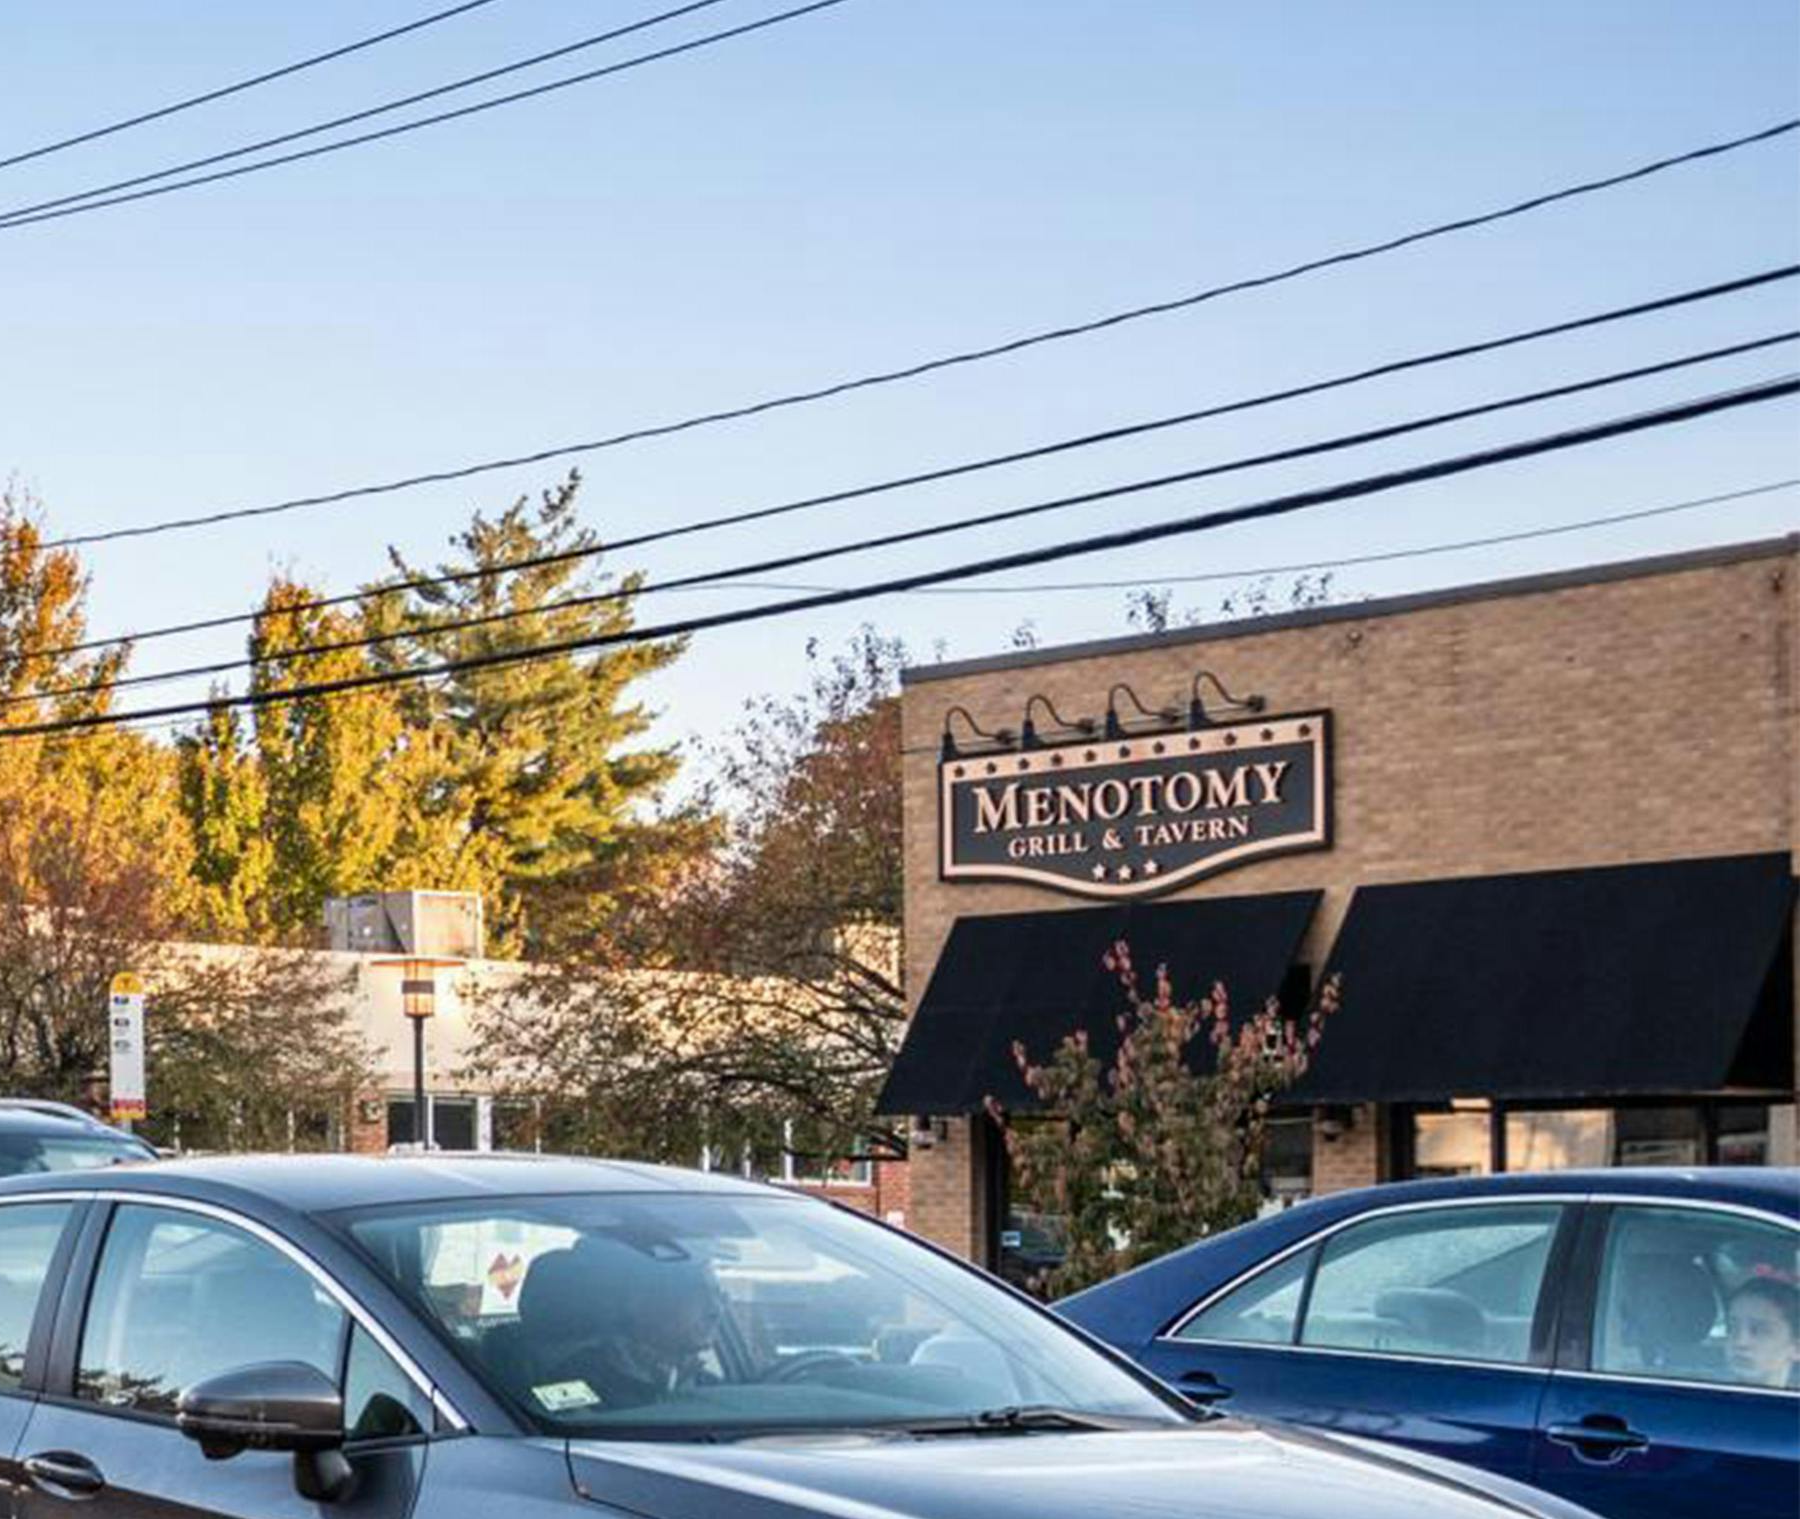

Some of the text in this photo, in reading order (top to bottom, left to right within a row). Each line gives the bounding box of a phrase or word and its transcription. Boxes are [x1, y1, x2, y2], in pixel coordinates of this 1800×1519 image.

[1009, 815, 1249, 859] GRILL & TAVERN
